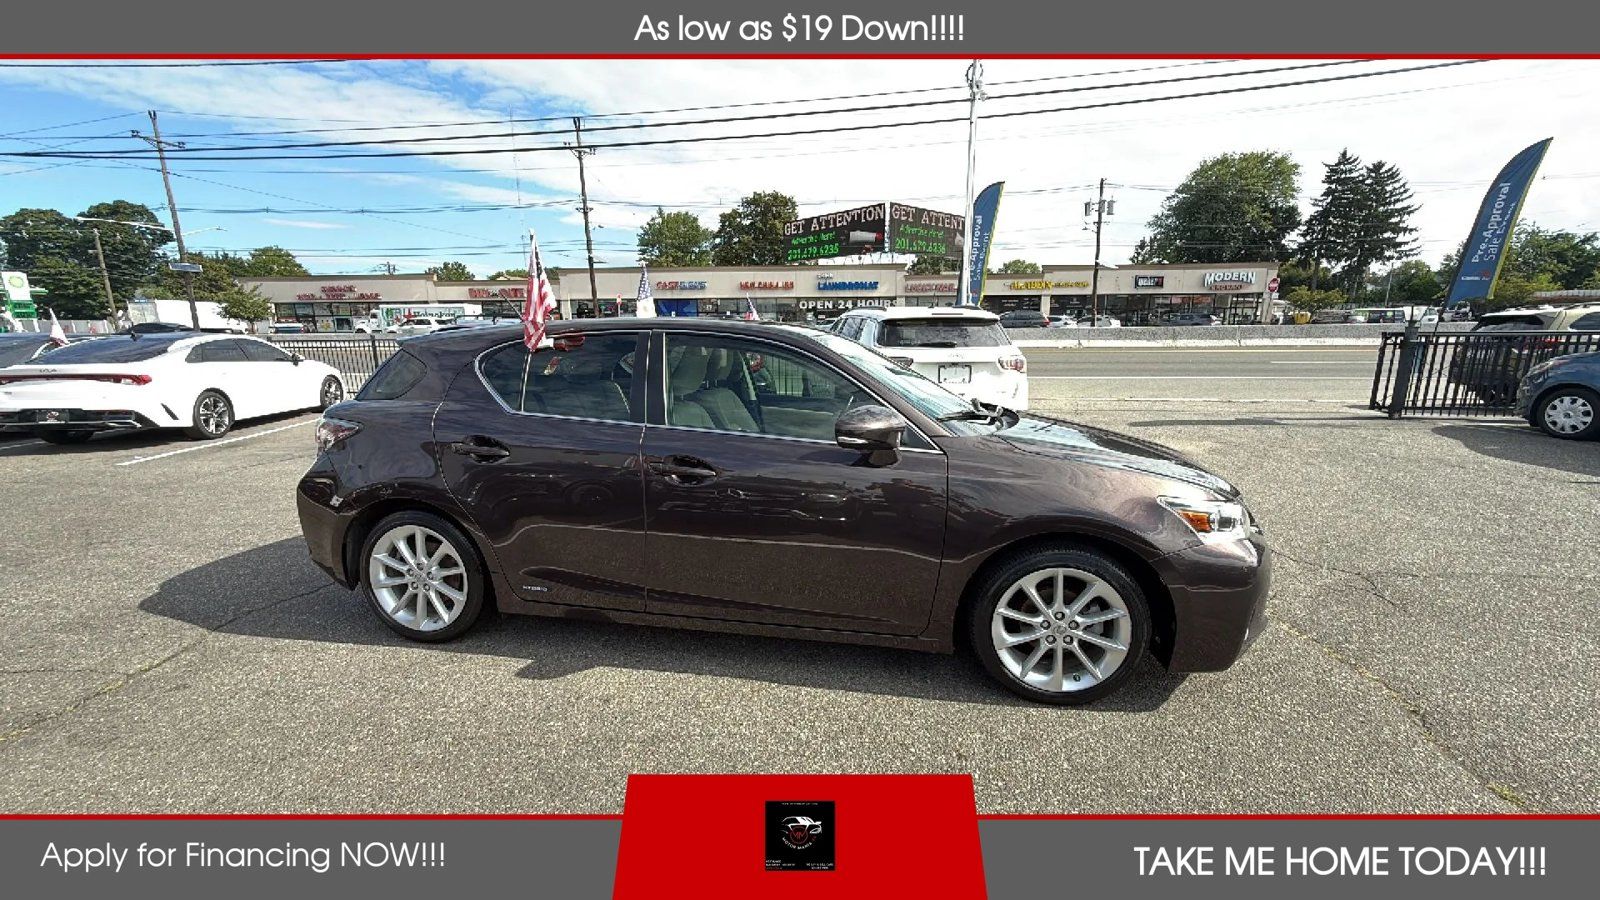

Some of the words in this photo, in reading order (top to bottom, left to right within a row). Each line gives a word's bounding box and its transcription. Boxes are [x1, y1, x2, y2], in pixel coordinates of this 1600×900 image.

[784, 220, 805, 235] GET
[811, 204, 885, 231] ATTENTION
[891, 204, 916, 222] GET
[1471, 182, 1512, 263] Pre-Approval
[1483, 237, 1502, 261] Sale
[816, 281, 879, 291] LAUNDROMAT
[1204, 271, 1256, 288] MODERN
[799, 300, 833, 310] OPEN
[837, 300, 853, 309] 24
